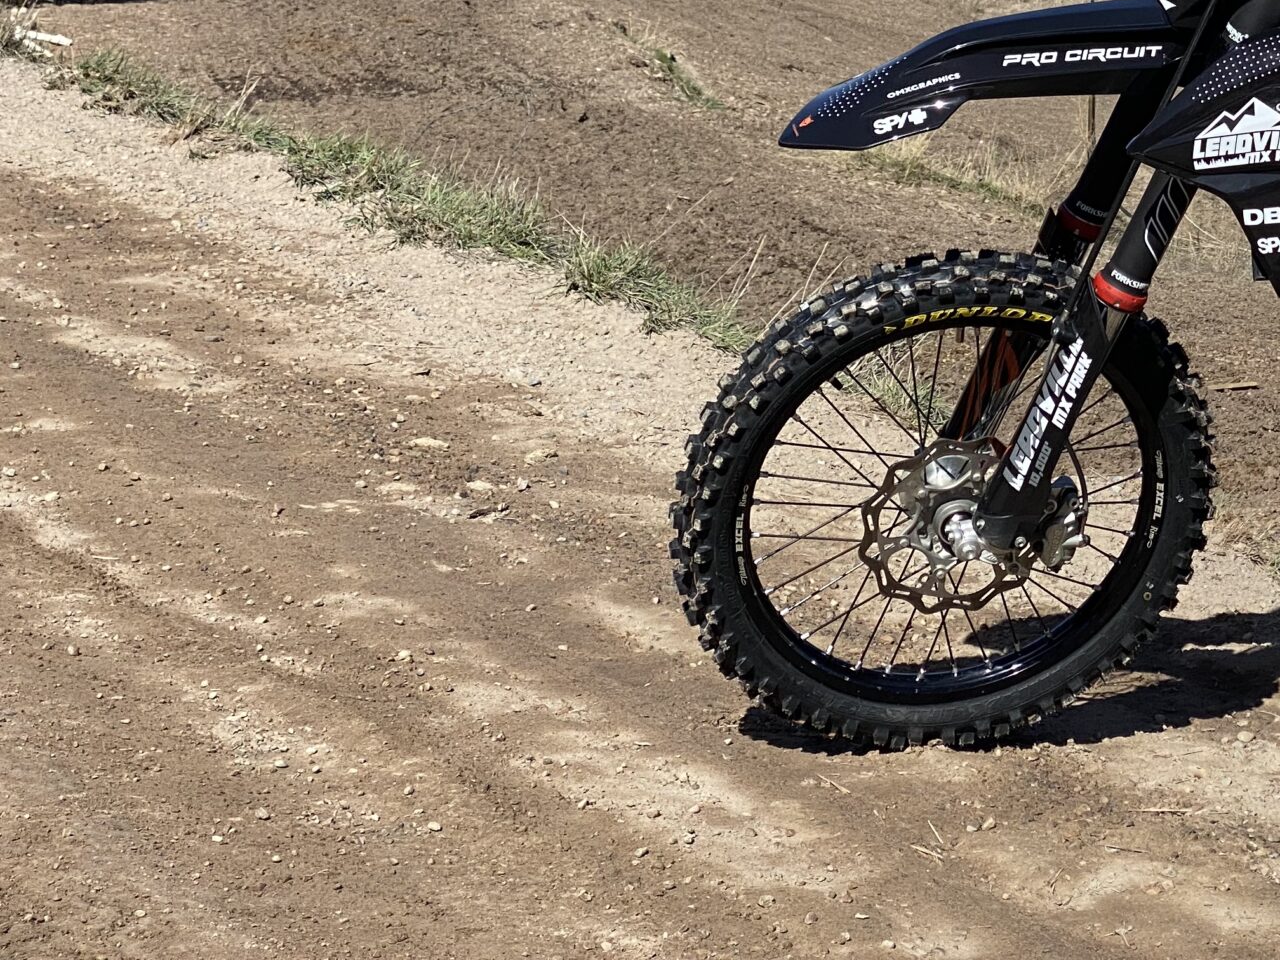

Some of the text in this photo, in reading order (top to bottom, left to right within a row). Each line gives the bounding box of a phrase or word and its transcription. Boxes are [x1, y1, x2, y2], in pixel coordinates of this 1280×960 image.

[1002, 45, 1163, 67] PRO CIRCUIT
[1245, 149, 1273, 165] MX
[902, 306, 1054, 329] DUNLOP
[1051, 350, 1093, 430] MX PARK
[1152, 482, 1165, 521] EXCEL
[735, 513, 745, 553] EXCEL
